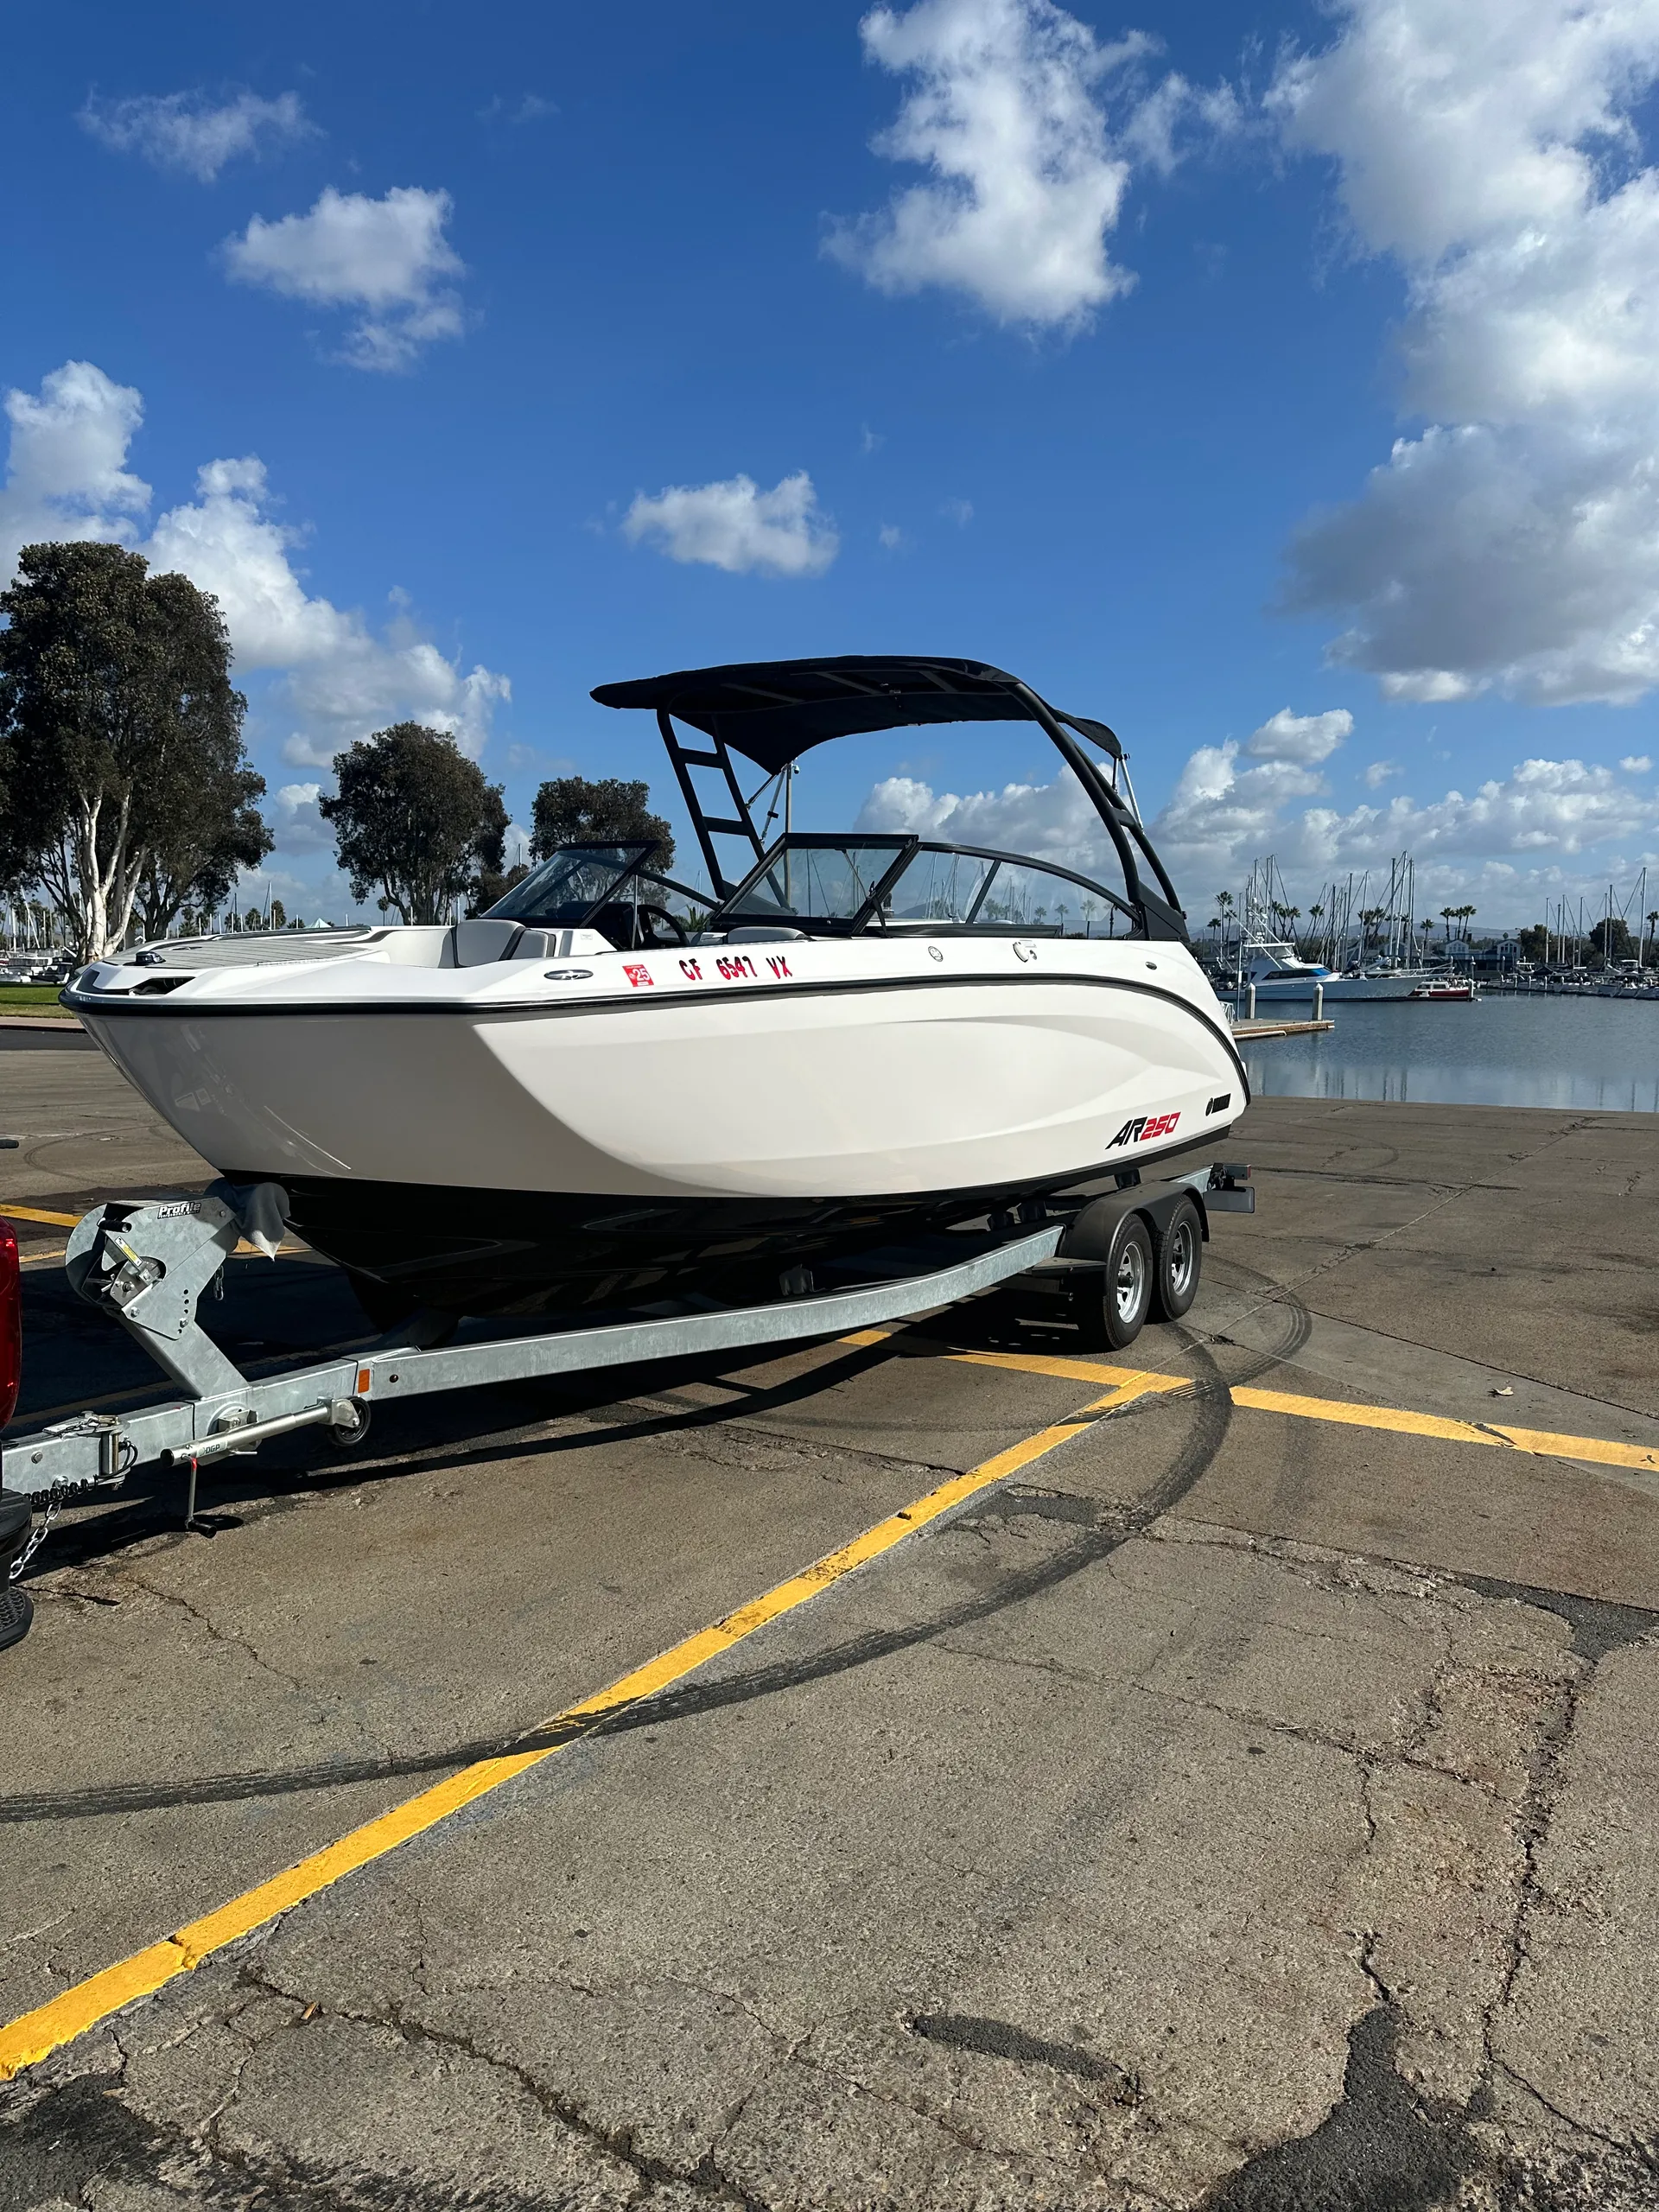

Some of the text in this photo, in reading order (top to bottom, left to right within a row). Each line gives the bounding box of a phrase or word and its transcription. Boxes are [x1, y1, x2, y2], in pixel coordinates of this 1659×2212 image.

[632, 968, 650, 982] 25
[679, 956, 792, 980] CF 6547 VX
[1105, 1111, 1181, 1149] AR250
[158, 1202, 201, 1217] Profile
